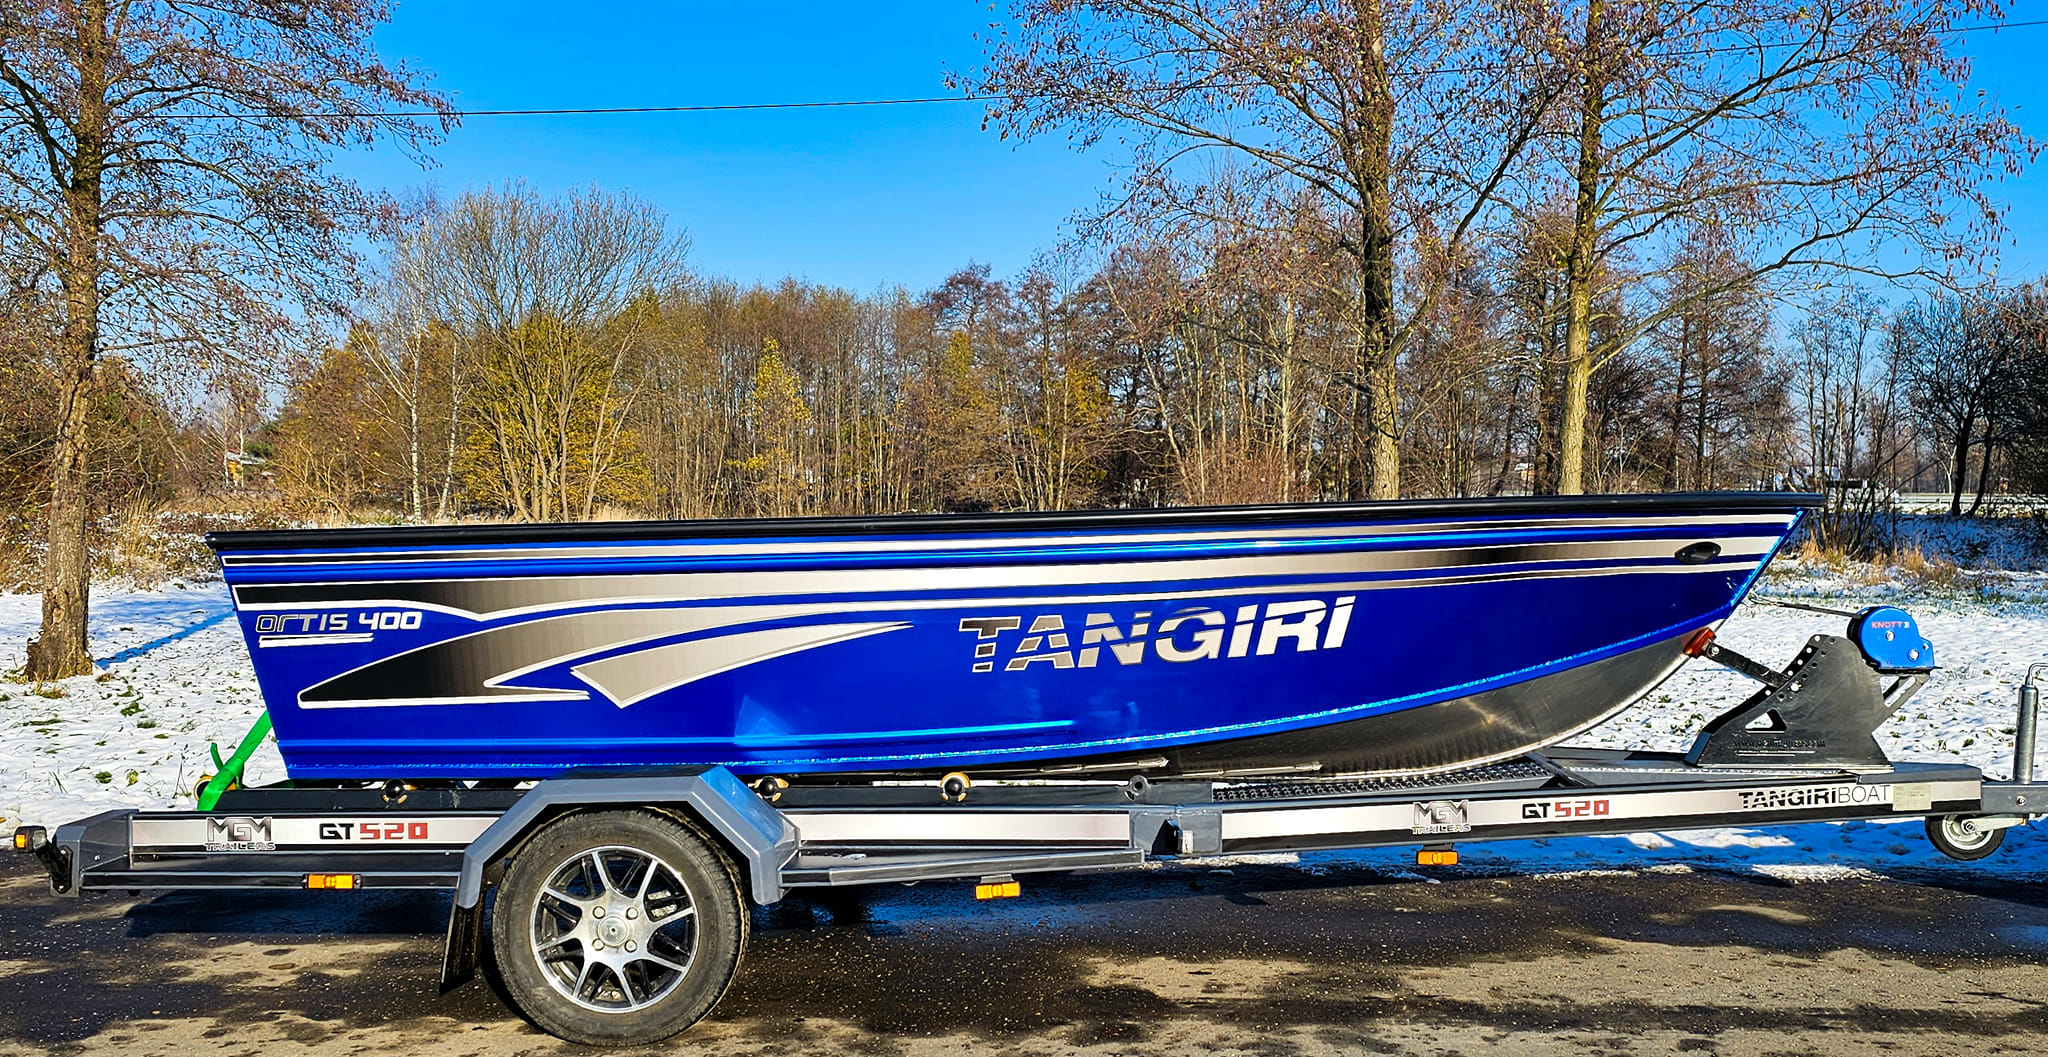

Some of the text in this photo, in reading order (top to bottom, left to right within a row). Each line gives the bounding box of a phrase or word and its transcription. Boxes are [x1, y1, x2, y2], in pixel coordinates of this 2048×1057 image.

[358, 611, 423, 631] 400
[1871, 621, 1904, 630] KNOTT
[959, 595, 1356, 674] TANGIRI
[1413, 800, 1469, 825] MGM
[207, 817, 272, 842] MGM
